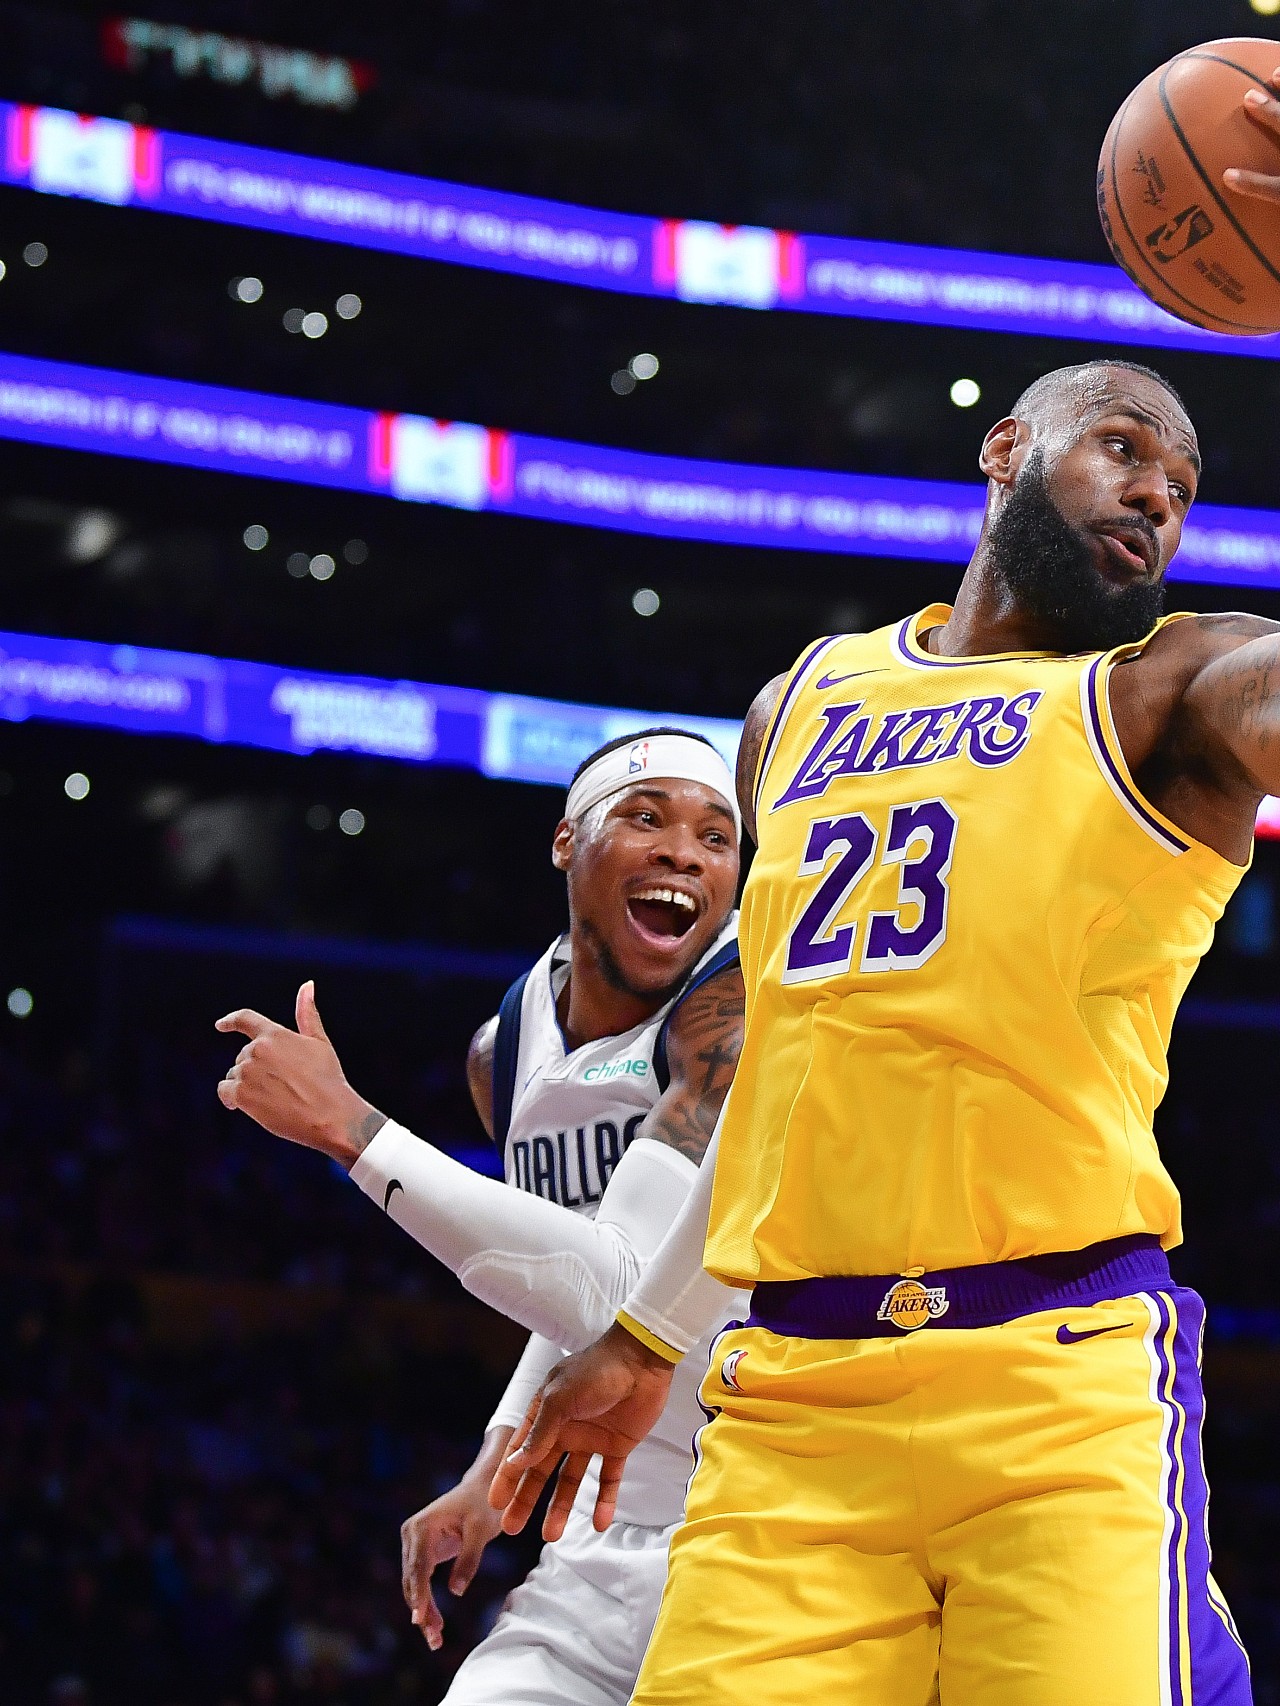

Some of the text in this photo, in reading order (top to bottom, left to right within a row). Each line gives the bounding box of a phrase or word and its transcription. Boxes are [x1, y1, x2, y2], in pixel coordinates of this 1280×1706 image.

[768, 690, 1046, 815] LAKERS
[781, 797, 959, 985] 23
[584, 1058, 648, 1081] chime
[883, 1294, 946, 1317] LAKERS
